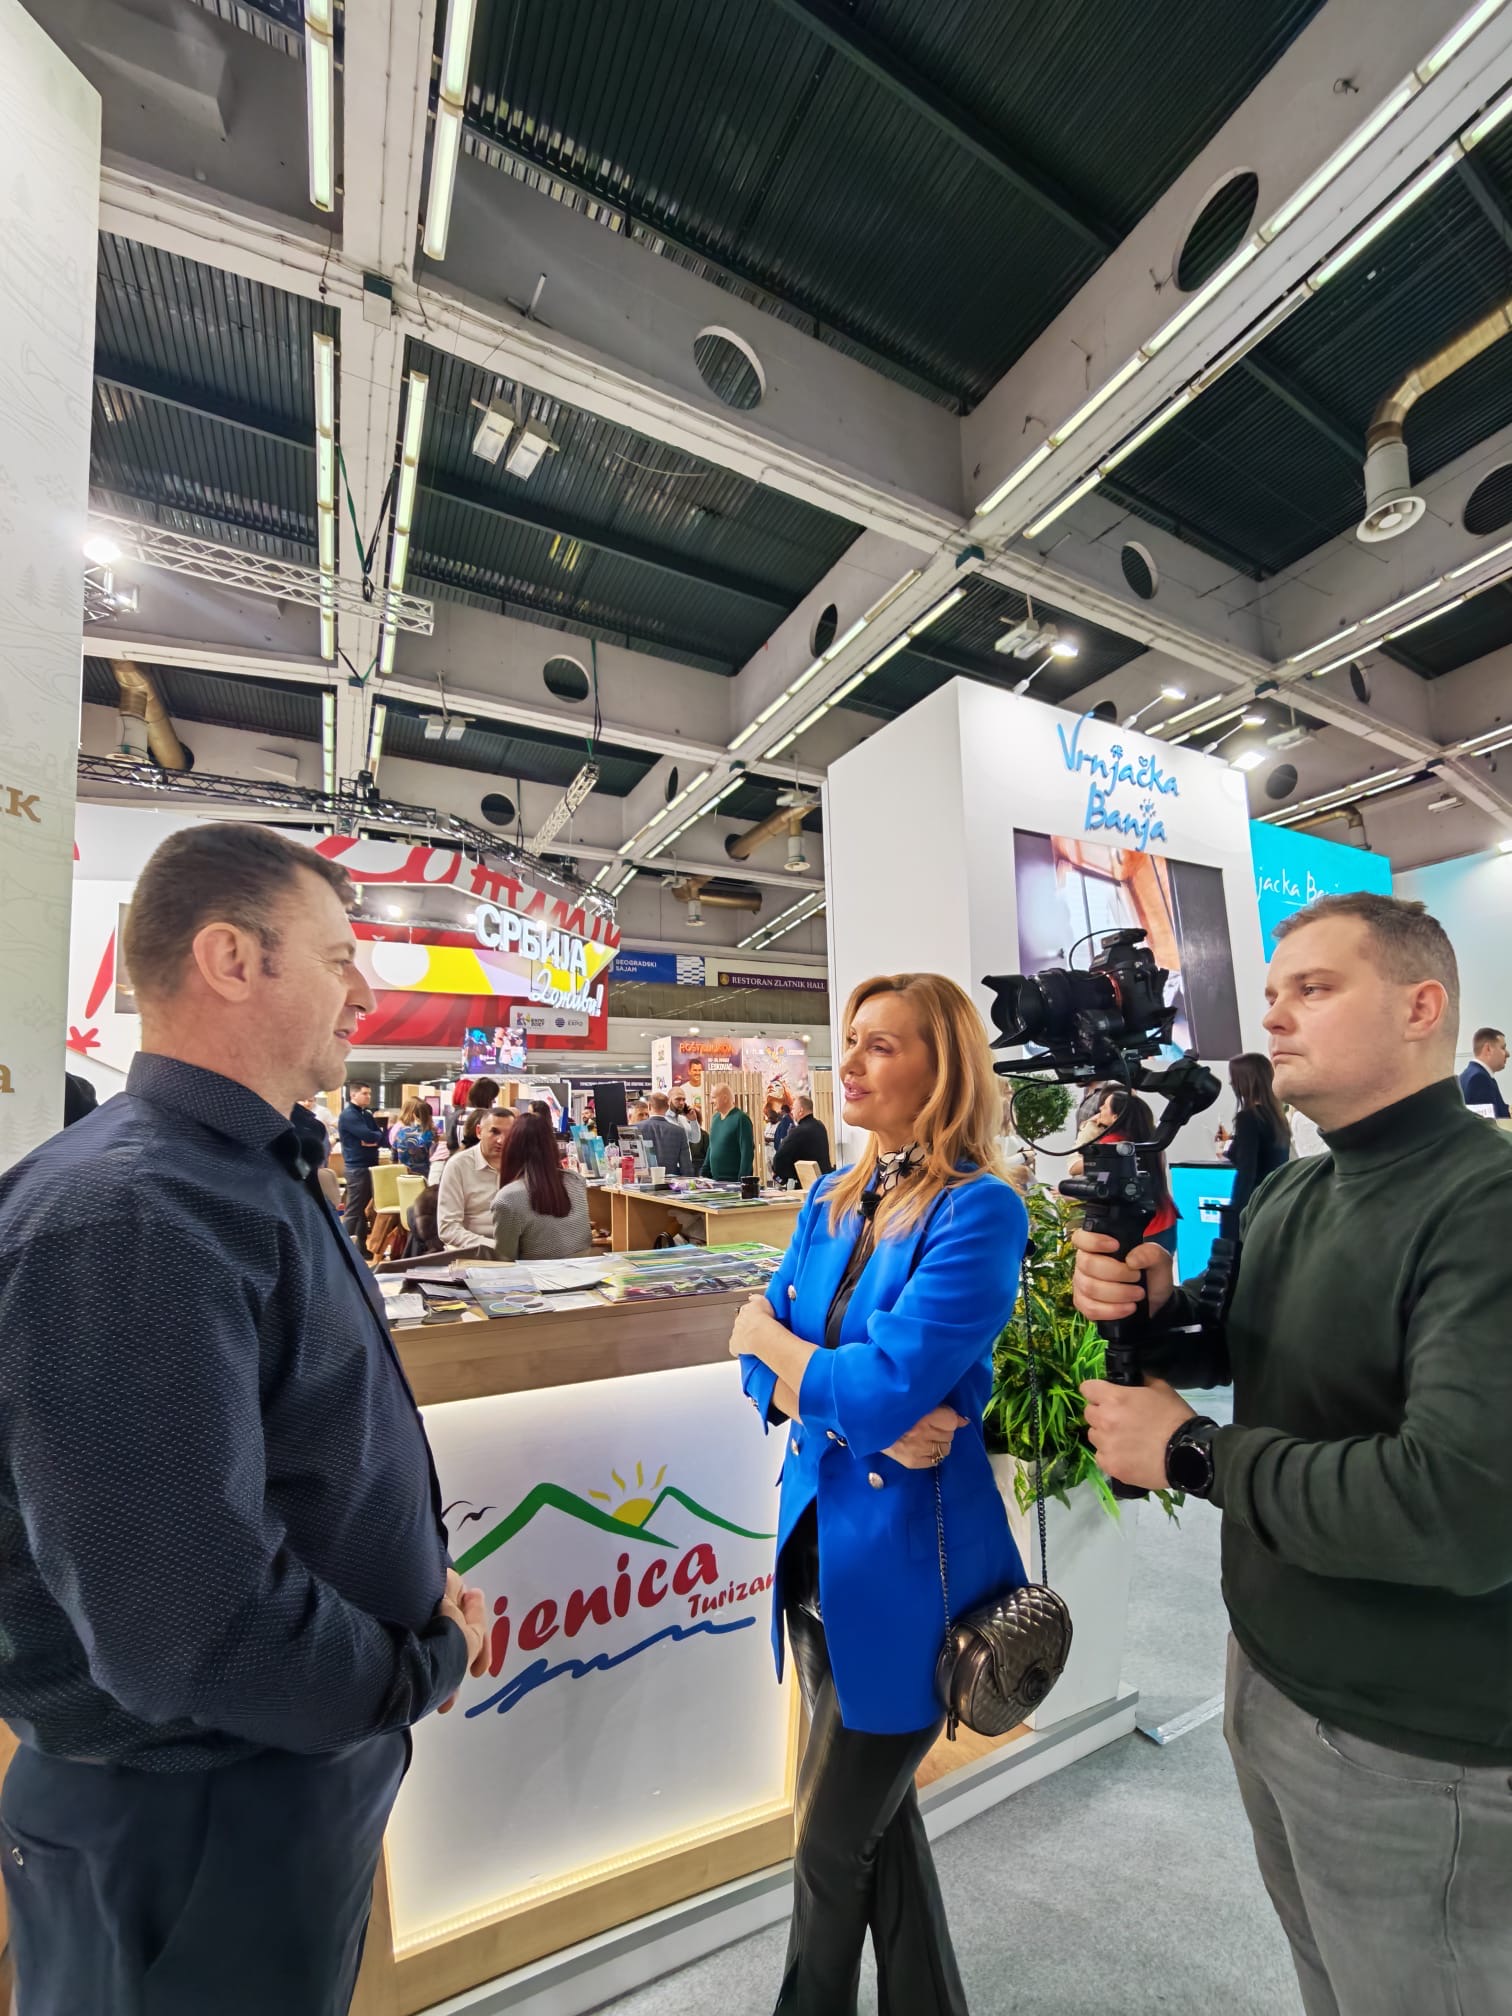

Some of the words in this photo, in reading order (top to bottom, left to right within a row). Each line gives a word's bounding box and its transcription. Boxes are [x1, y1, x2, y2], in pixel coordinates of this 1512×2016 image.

[1057, 711, 1179, 797] Vrnjačka
[1084, 781, 1167, 852] Banja
[1256, 866, 1301, 905] jacka
[474, 903, 588, 977] СРБИЈА
[615, 959, 657, 968] BEOGRADSKI
[732, 976, 773, 986] RESTORAN
[774, 979, 806, 989] ZLATNIK
[806, 981, 825, 990] HALL
[488, 1543, 719, 1678] jenica
